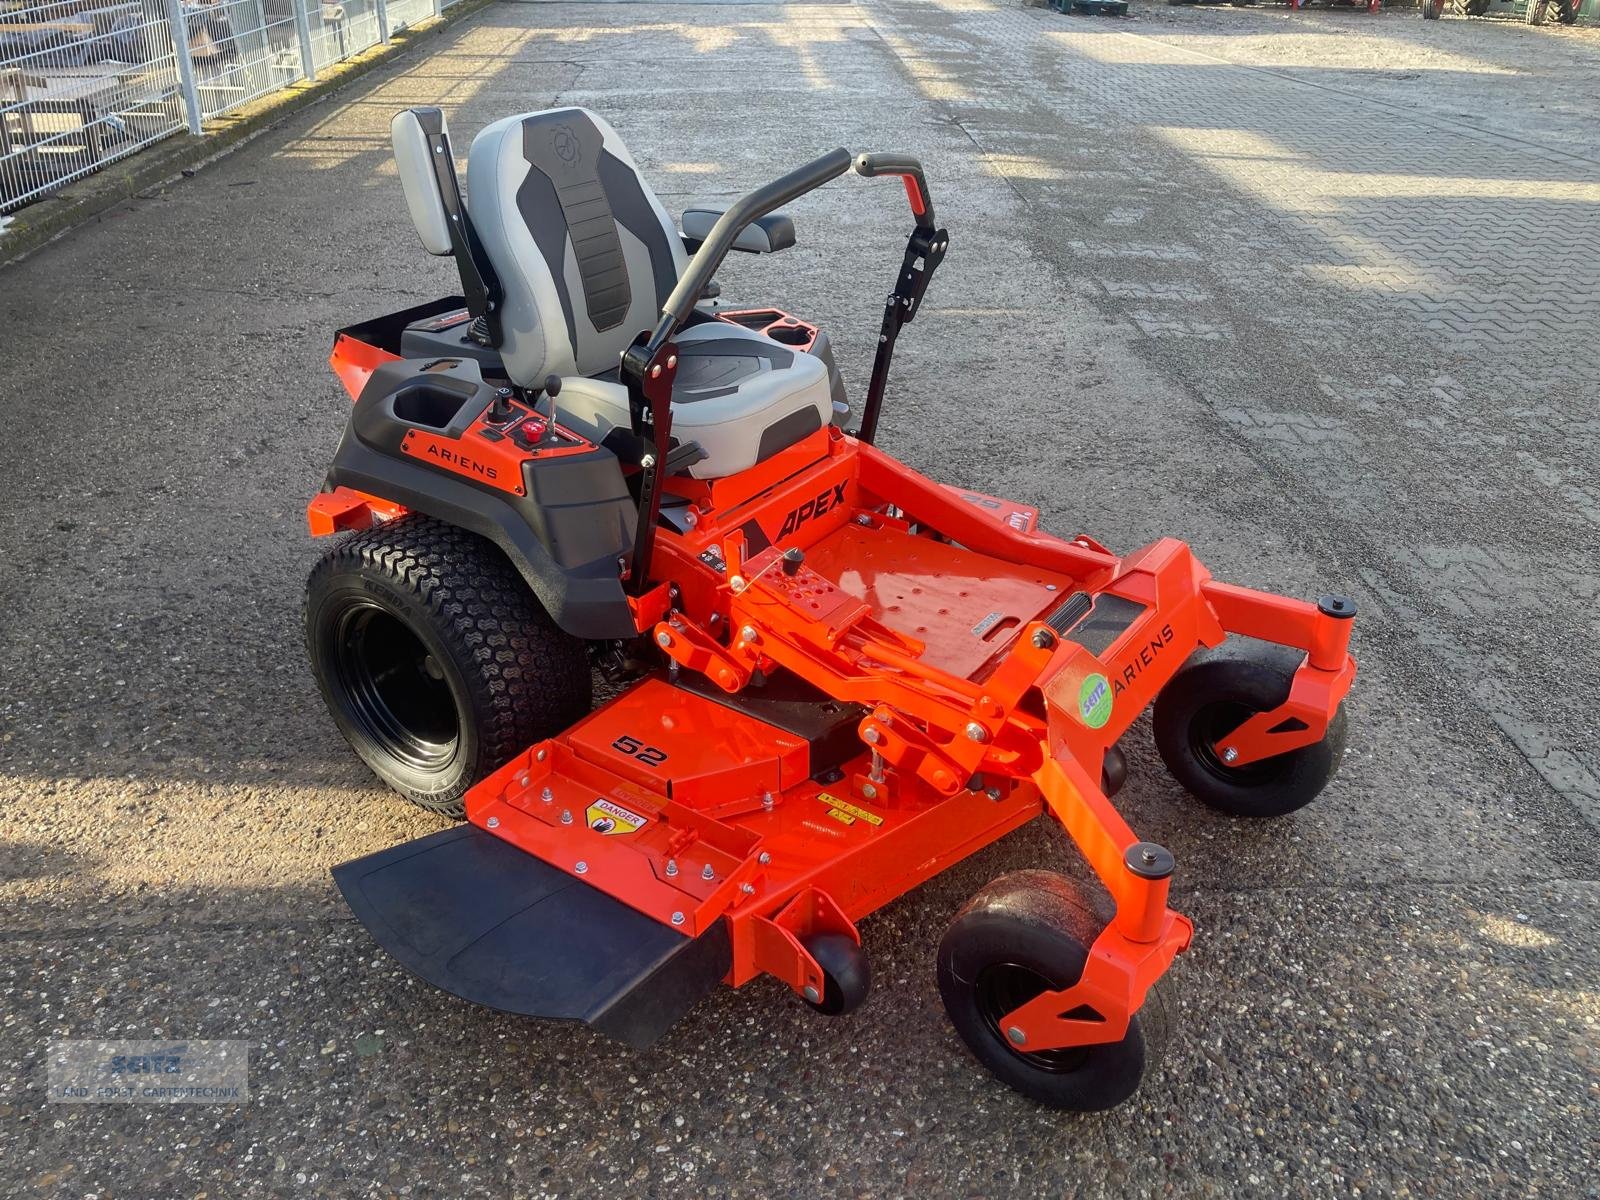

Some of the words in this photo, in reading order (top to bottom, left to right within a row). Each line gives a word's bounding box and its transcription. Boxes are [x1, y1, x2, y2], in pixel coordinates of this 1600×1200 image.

[428, 444, 497, 479] ARIENS
[774, 479, 849, 544] APEX
[1114, 623, 1174, 698] ARIENS
[612, 735, 667, 767] 52
[600, 802, 640, 825] DANGER
